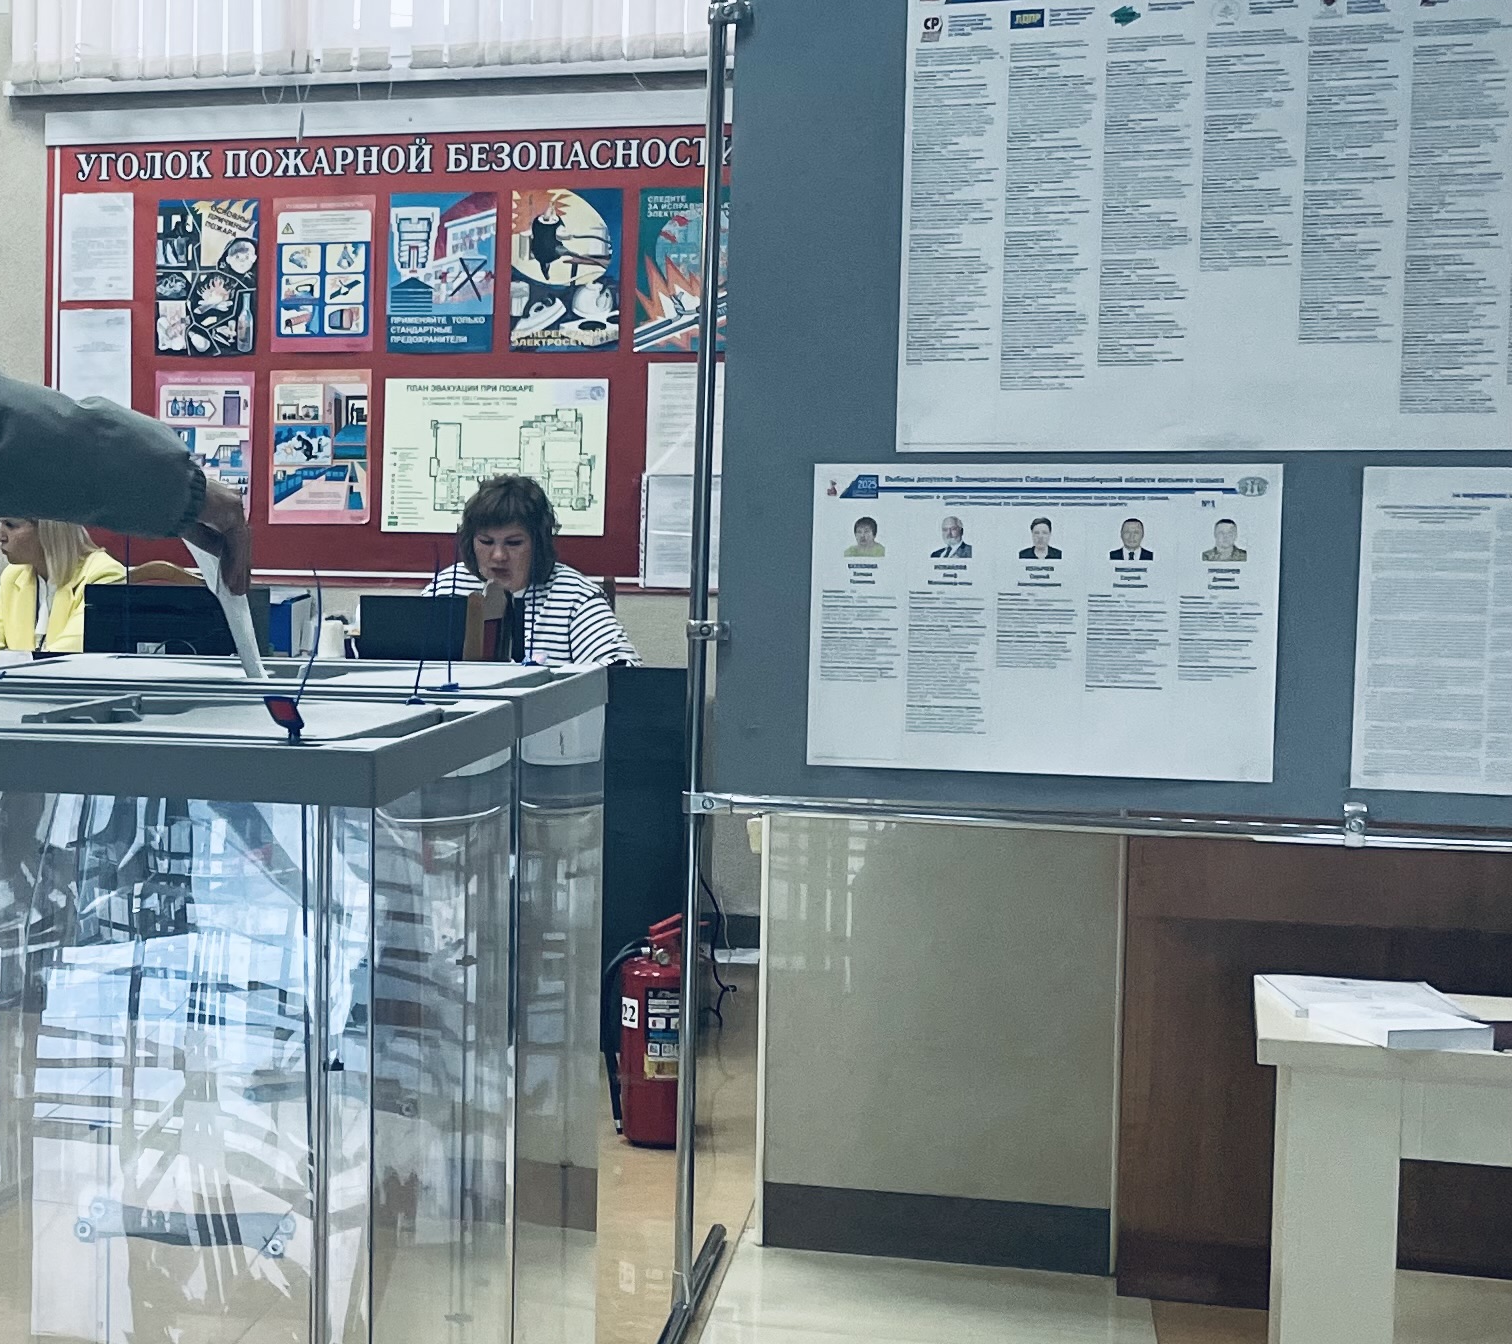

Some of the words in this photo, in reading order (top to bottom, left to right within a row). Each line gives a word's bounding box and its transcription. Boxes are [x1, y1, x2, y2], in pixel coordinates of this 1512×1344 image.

[76, 151, 211, 182] УГОЛОК
[223, 138, 433, 179] ПОЖАРНОЙ
[451, 316, 486, 324] ТОЛЬКО
[390, 325, 453, 334] СТАНДАРТНЫЕ
[390, 335, 468, 344] ПРЕДОХРАНИТЕЛИ
[406, 384, 429, 392] ПЛАН
[430, 384, 479, 393] ЭВАКУАЦИИ
[498, 384, 534, 392] ПОЖАРЕ
[857, 480, 878, 490] 2025
